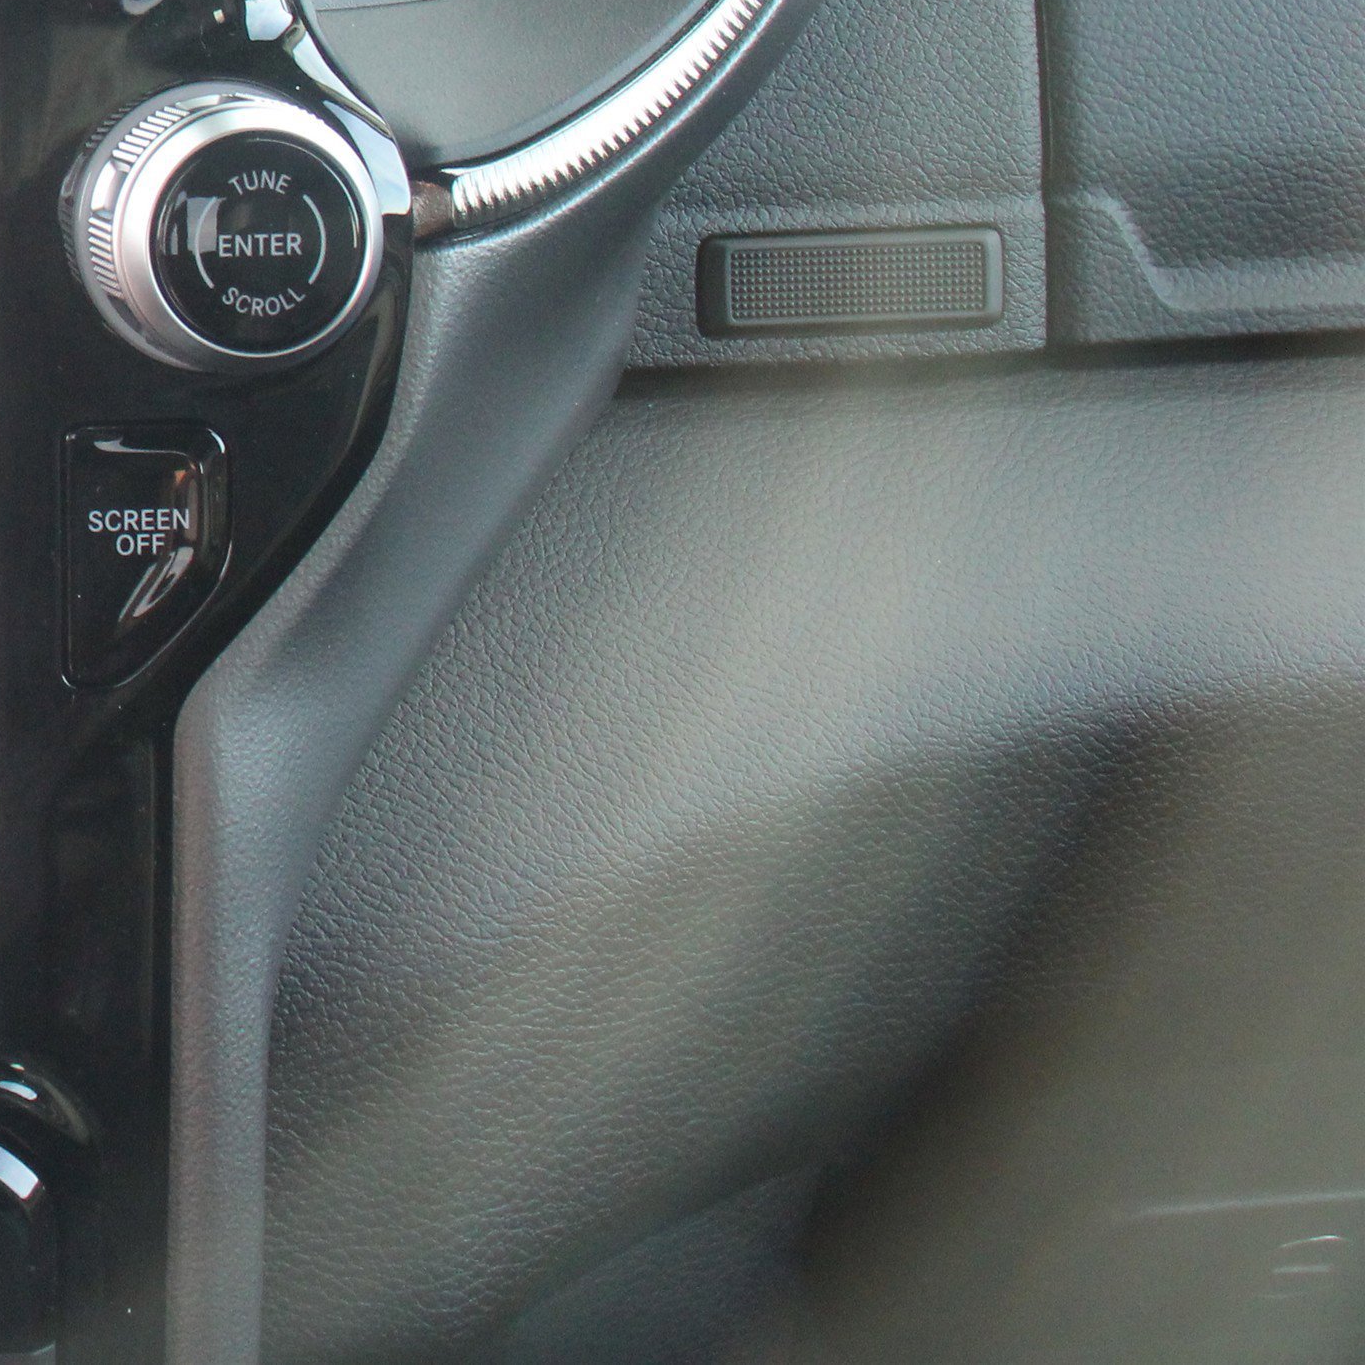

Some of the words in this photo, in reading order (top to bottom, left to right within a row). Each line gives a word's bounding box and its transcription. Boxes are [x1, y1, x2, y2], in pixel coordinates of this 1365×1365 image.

[228, 169, 293, 196] TUNE
[218, 233, 303, 258] ENTER
[221, 285, 306, 317] SCROLL
[87, 508, 190, 534] SCREEN
[115, 533, 167, 557] OFF
